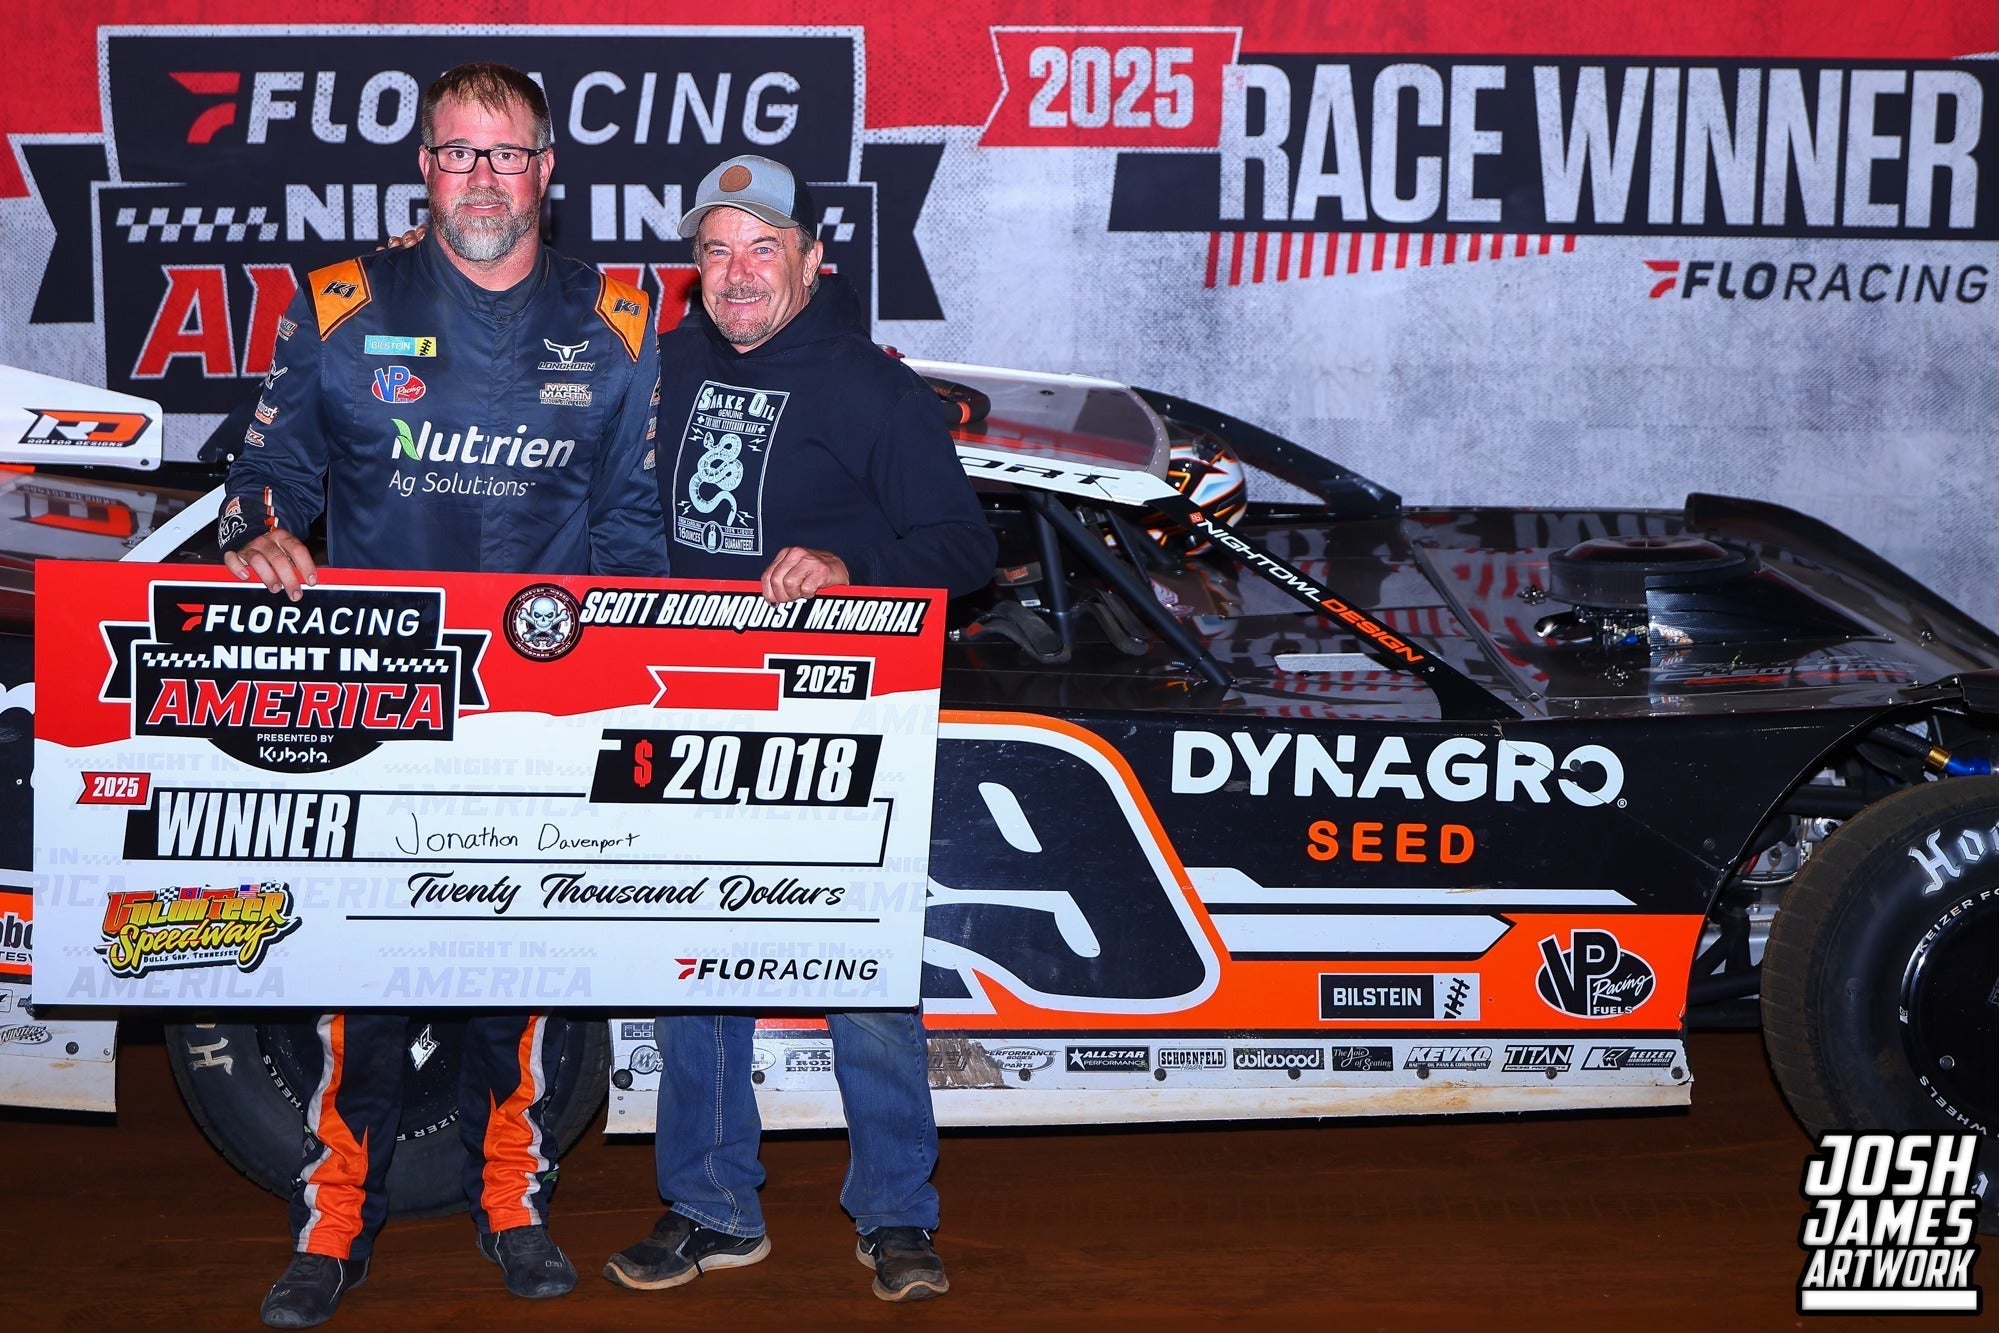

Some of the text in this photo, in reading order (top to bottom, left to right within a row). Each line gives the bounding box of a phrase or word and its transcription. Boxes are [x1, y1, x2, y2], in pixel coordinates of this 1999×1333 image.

[1028, 46, 1195, 129] 2025
[1219, 63, 1984, 229] RACE WINNER
[591, 184, 684, 242] IN
[1682, 260, 1988, 303] FLORACING
[371, 341, 411, 350] BILSTEIN
[538, 360, 596, 371] LONGHORN
[540, 391, 592, 400] MARTIN
[545, 383, 590, 393] MARK
[717, 408, 744, 420] GENUINE
[747, 392, 776, 422] OIL
[75, 440, 125, 448] DESIGNS
[391, 418, 576, 468] Nutrien
[388, 469, 417, 497] Ag
[205, 604, 421, 637] FLORACING
[580, 590, 927, 633] SCOTT BLOOMQUIST MEMORIAL
[213, 645, 380, 672] NIGHT IN
[793, 664, 857, 694] 2025
[145, 678, 444, 731] AMERICA
[256, 733, 334, 742] PRESENTED BY
[633, 734, 858, 806] $ 20,018
[1171, 730, 1625, 808] DYNAGRO
[92, 776, 140, 798] 2025
[157, 791, 351, 858] WINNER
[395, 812, 641, 856] Jonathon Davenport
[1307, 820, 1476, 864] SEED
[407, 870, 523, 915] Twenty
[540, 870, 711, 910] Thousand
[719, 874, 846, 912] Dollars
[1918, 898, 1975, 953] KEIZER
[109, 918, 276, 968] Speedway
[143, 955, 169, 963] BULLS
[193, 949, 239, 959] TENNESSEE
[697, 958, 880, 981] FLORACING
[1538, 929, 1622, 1017] VP
[1333, 987, 1422, 1006] BILSTEIN
[1593, 972, 1653, 1001] Racing
[1593, 1006, 1633, 1014] FUELS
[1081, 1050, 1146, 1059] ALLSTAR
[1083, 1059, 1147, 1067] PERFORMANCE
[1160, 1051, 1224, 1065] SCHOENFELD
[1236, 1049, 1320, 1068] wilwood
[1333, 1048, 1348, 1057] The
[1354, 1057, 1392, 1071] of Seating
[1408, 1047, 1492, 1061] KEVKO
[1507, 1046, 1572, 1065] TITAN
[1629, 1051, 1675, 1059] KEIZER
[263, 1055, 303, 1113] HEELS
[1919, 1075, 1988, 1136] WHEELS
